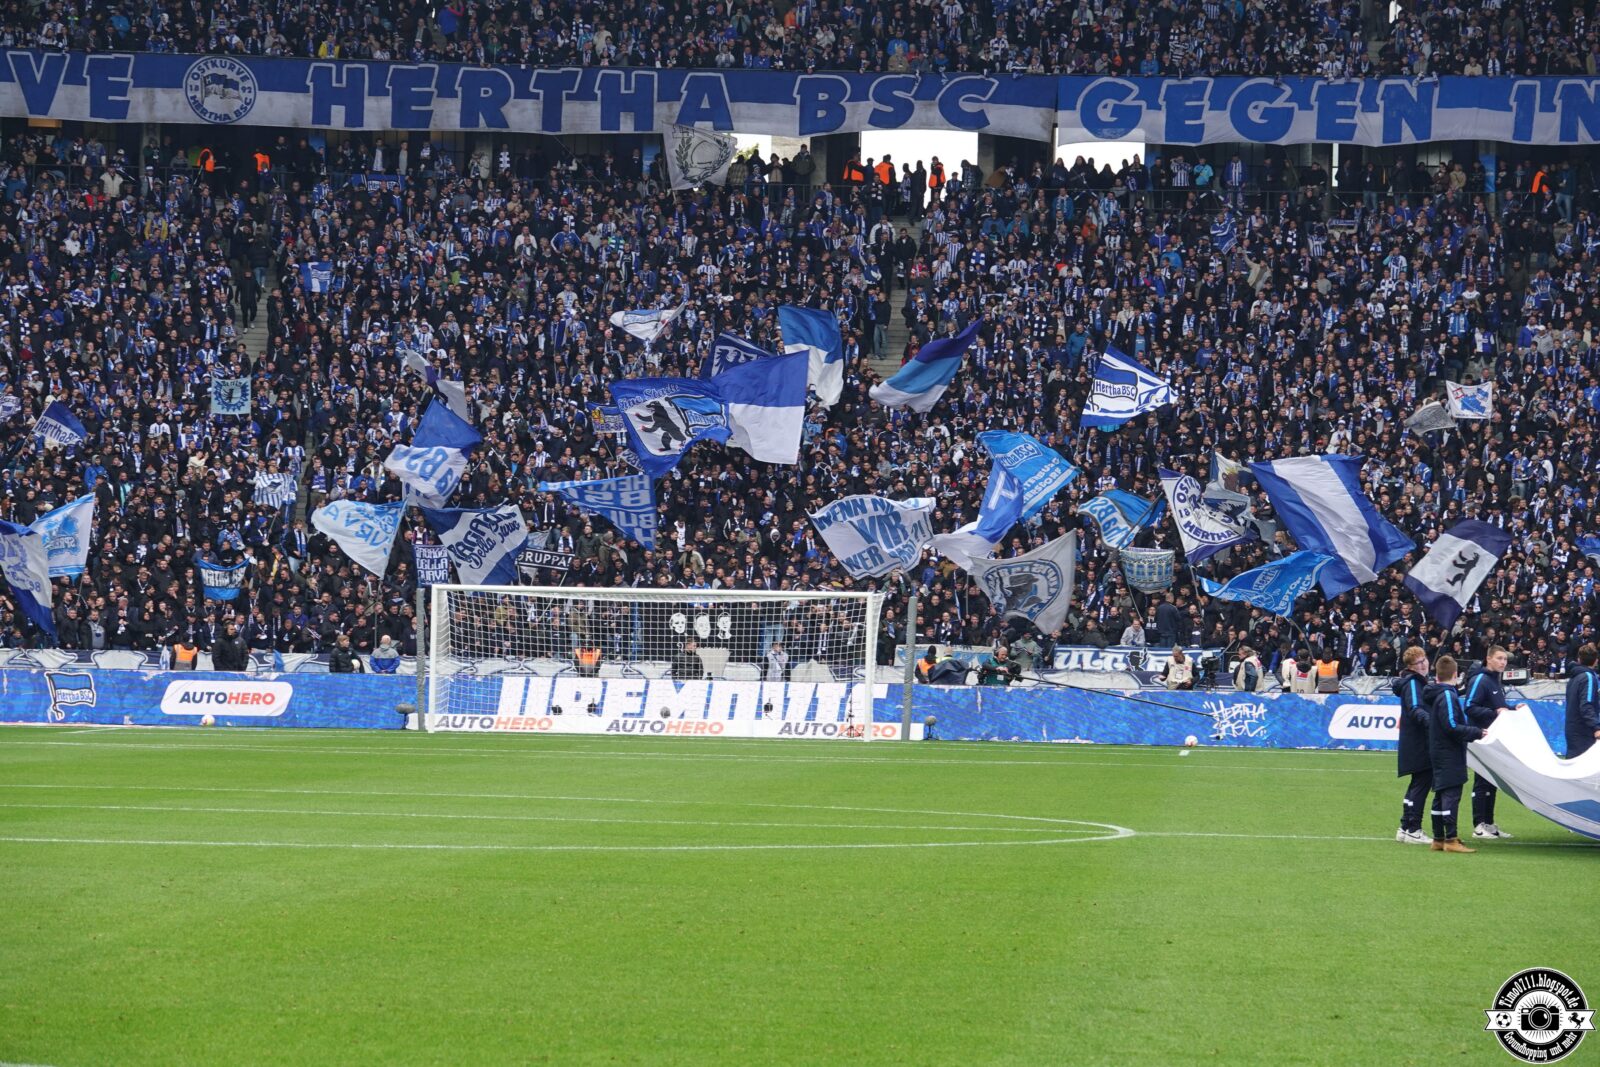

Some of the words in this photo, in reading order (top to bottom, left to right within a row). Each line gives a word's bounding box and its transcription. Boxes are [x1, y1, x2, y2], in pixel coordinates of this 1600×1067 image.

[190, 60, 250, 83] OSTKURVE
[190, 95, 231, 121] HERTHA
[233, 97, 253, 117] BSC
[306, 62, 735, 132] HERTHA
[793, 74, 999, 136] BSC
[1076, 76, 1440, 142] GEGEN
[1096, 381, 1121, 396] Hertha
[1121, 386, 1136, 397] BSC
[812, 498, 868, 531] WENN
[1183, 520, 1236, 541] HERTHA
[841, 545, 885, 572] WER
[179, 691, 275, 705] AUTOHERO
[435, 716, 553, 730] AUTOHERO
[606, 719, 724, 735] AUTOHERO
